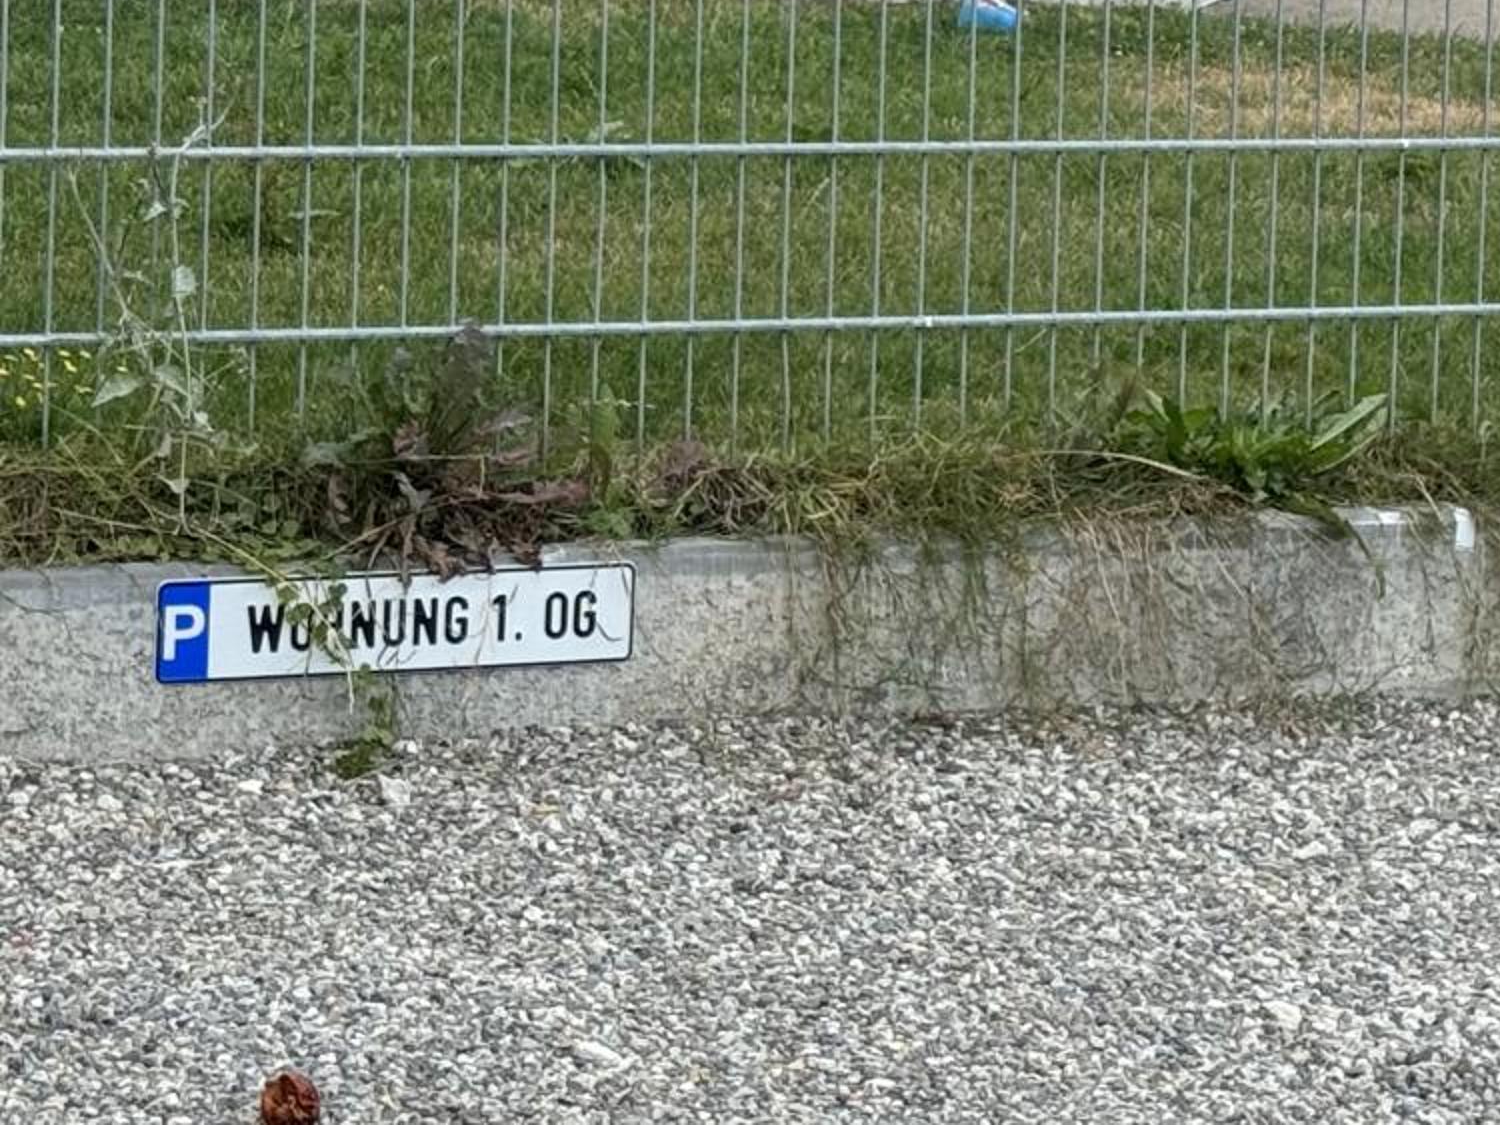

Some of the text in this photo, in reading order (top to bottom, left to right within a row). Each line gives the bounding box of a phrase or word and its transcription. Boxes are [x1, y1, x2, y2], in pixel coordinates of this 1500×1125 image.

[162, 604, 206, 660] P
[491, 594, 523, 642] 1.
[544, 589, 598, 639] OG
